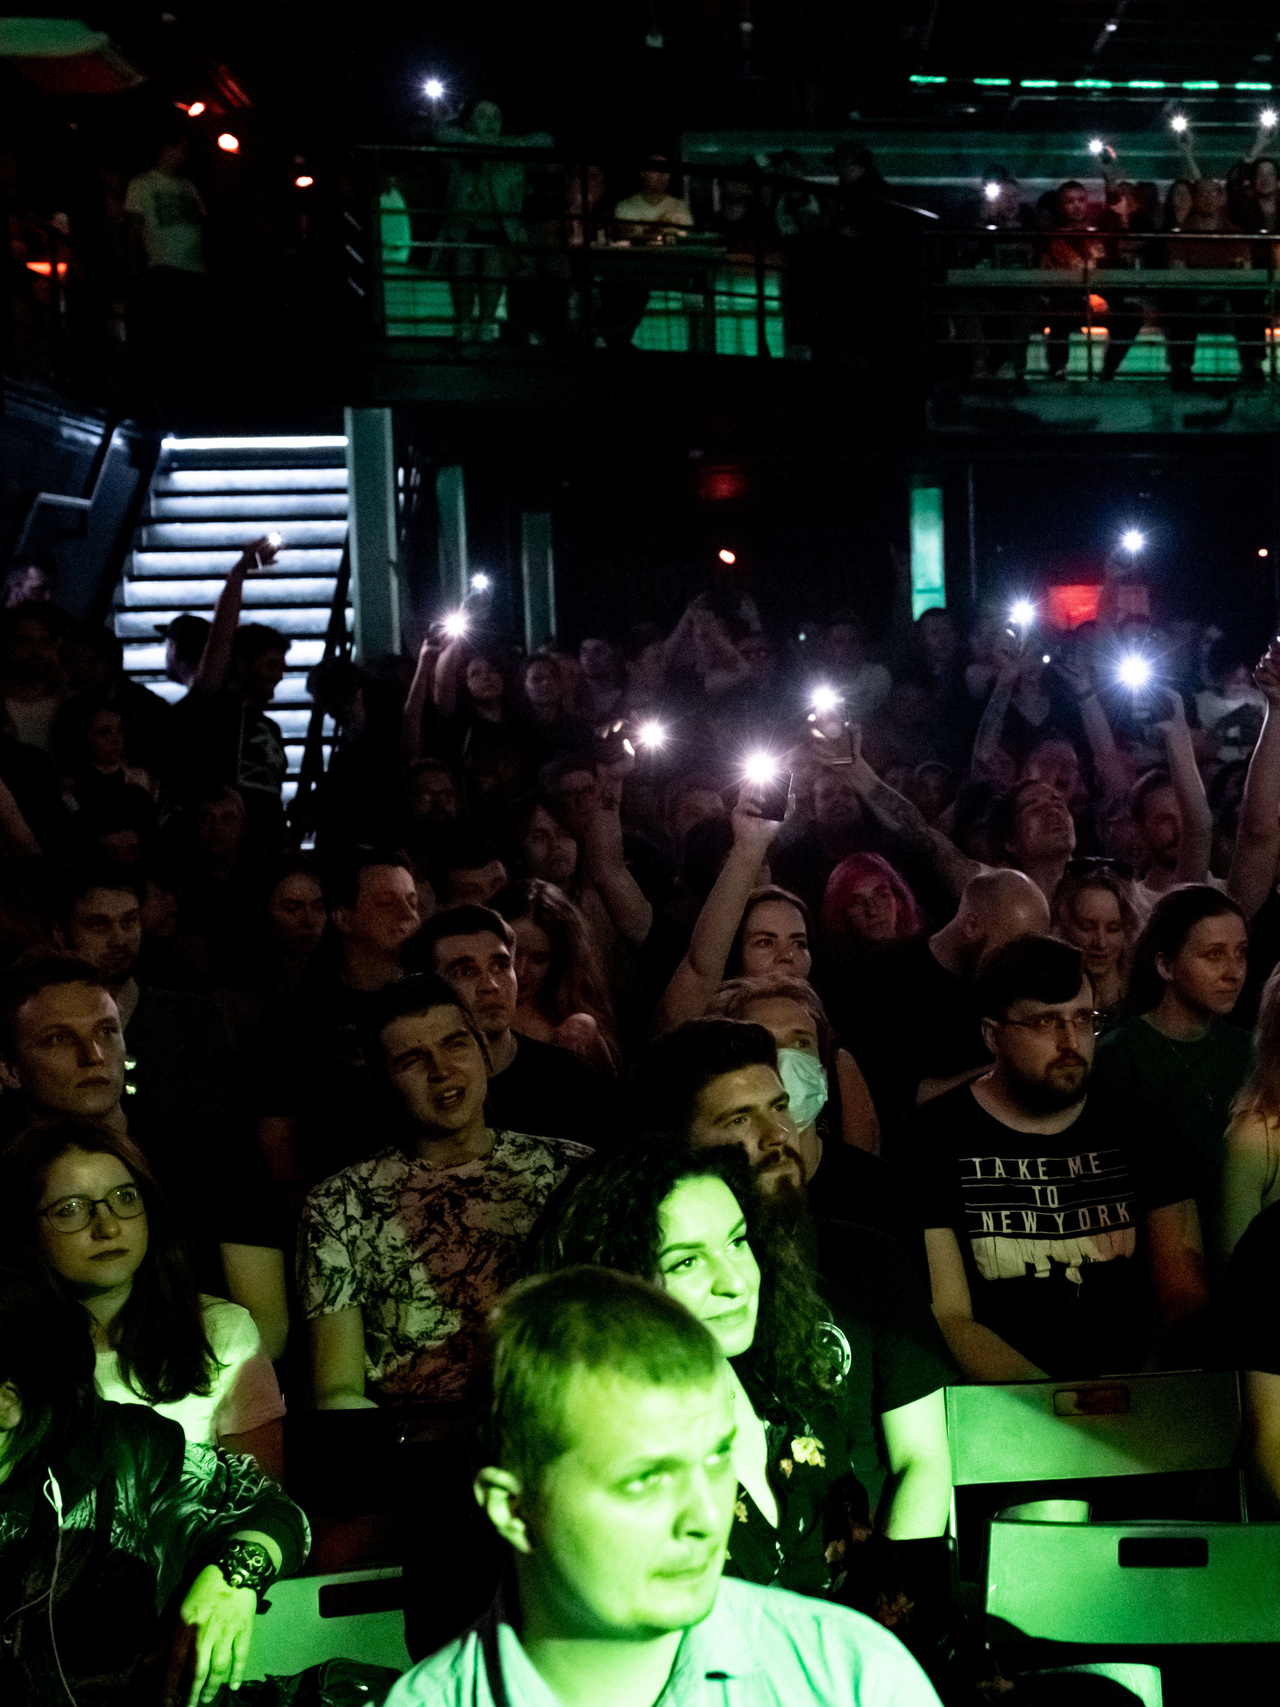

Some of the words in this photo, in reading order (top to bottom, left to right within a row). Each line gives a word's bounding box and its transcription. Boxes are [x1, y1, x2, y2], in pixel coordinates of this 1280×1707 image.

[972, 1157, 1049, 1181] TAKE
[1067, 1152, 1102, 1179] ME
[1031, 1186, 1059, 1208] TO
[981, 1211, 1037, 1234] NEW
[1053, 1202, 1131, 1235] YORK
